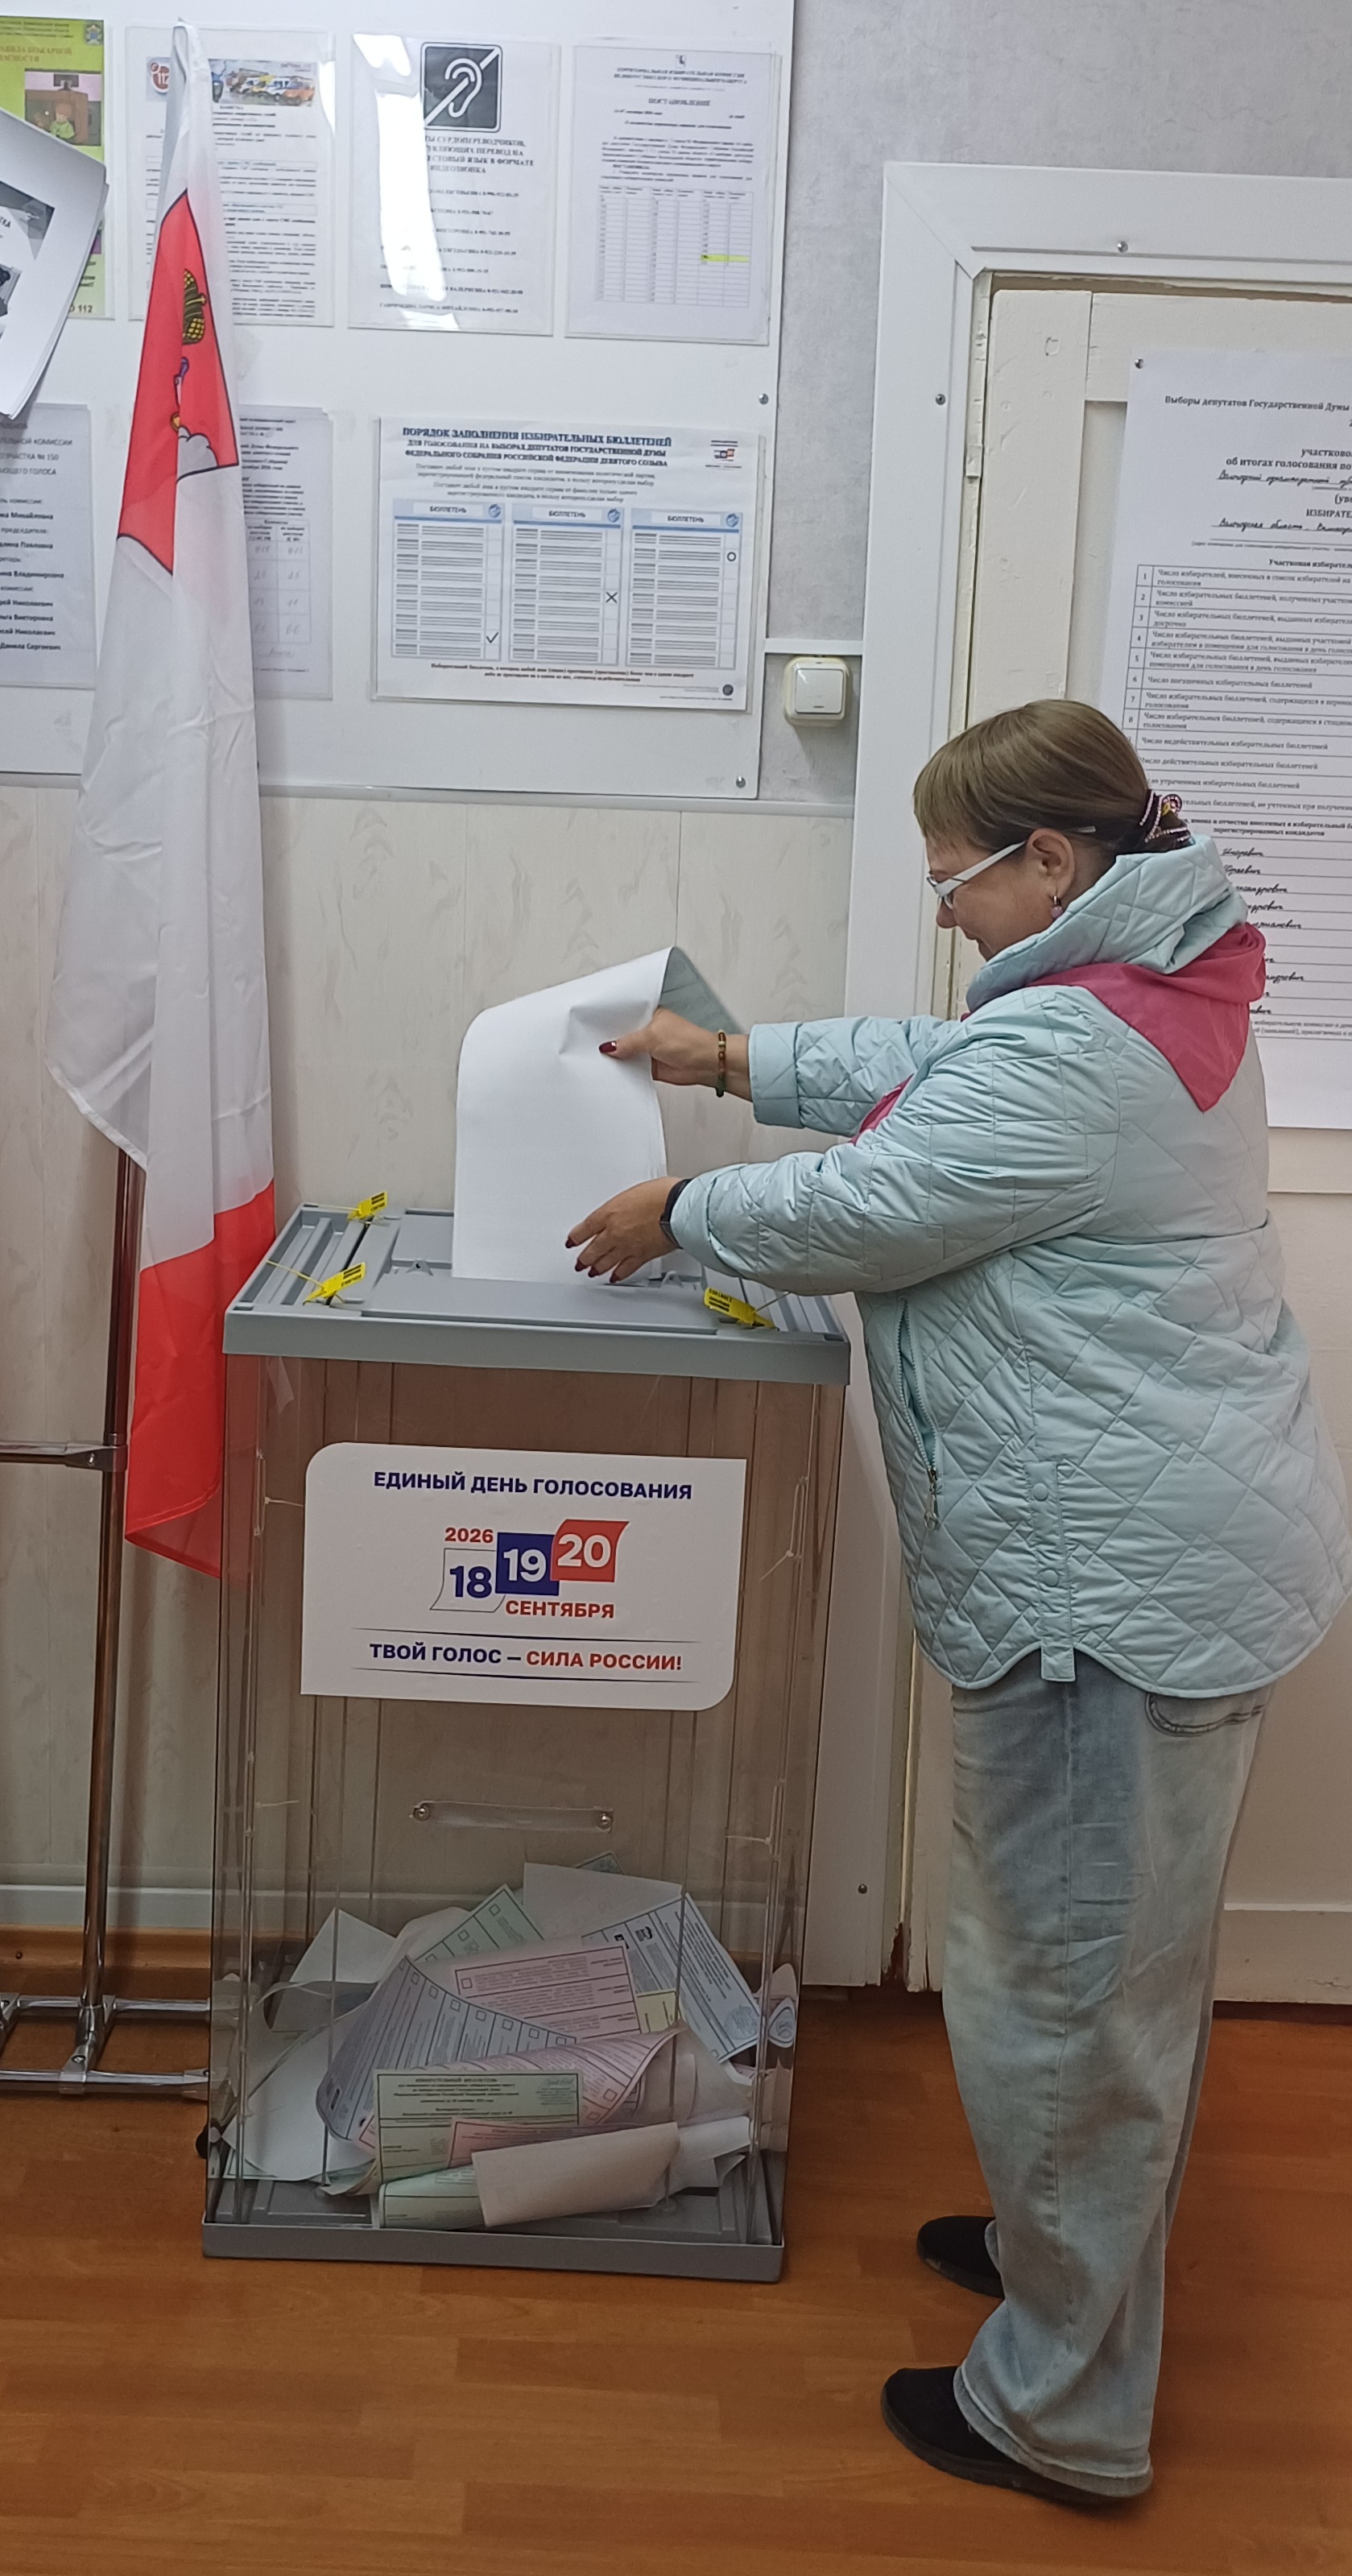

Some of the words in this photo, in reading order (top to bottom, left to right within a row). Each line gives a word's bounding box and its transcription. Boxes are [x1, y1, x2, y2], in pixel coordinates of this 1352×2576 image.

[77, 304, 93, 313] 112
[1164, 395, 1200, 405] Выборы
[1202, 399, 1247, 407] депутатов
[1249, 399, 1324, 409] Государственной
[1325, 403, 1350, 411] Думы
[403, 428, 449, 436] ПОРЯДОК
[452, 429, 519, 439] ЗАПОЛНЕНИЯ
[521, 432, 603, 443] ИЗБИРАТЕЛЬНЫХ
[606, 435, 672, 446] БЮЛЛЕТЕНЕЙ
[1300, 448, 1352, 457] участково
[1275, 460, 1337, 469] голосования
[1340, 461, 1351, 470] по
[1306, 509, 1352, 519] ИЗБИРАТЕ
[1312, 560, 1352, 569] избирател
[1314, 617, 1352, 625] избирател
[1310, 657, 1352, 665] избирателя
[1266, 971, 1304, 984] андрович
[374, 1471, 465, 1490] ЕДИНЫЙ
[470, 1477, 527, 1495] ДЕНЬ
[533, 1478, 693, 1499] ГОЛОСОВАНИЯ
[444, 1527, 494, 1543] 2026
[449, 1565, 493, 1598] 18
[503, 1548, 547, 1582] 19
[557, 1534, 611, 1569] 20
[506, 1600, 615, 1619] СЕНТЯБРЯ
[370, 1643, 425, 1660] ТВОЙ
[432, 1647, 502, 1664] ГОЛОС
[527, 1651, 585, 1668] СИЛА
[589, 1654, 683, 1670] РОССИИ!
